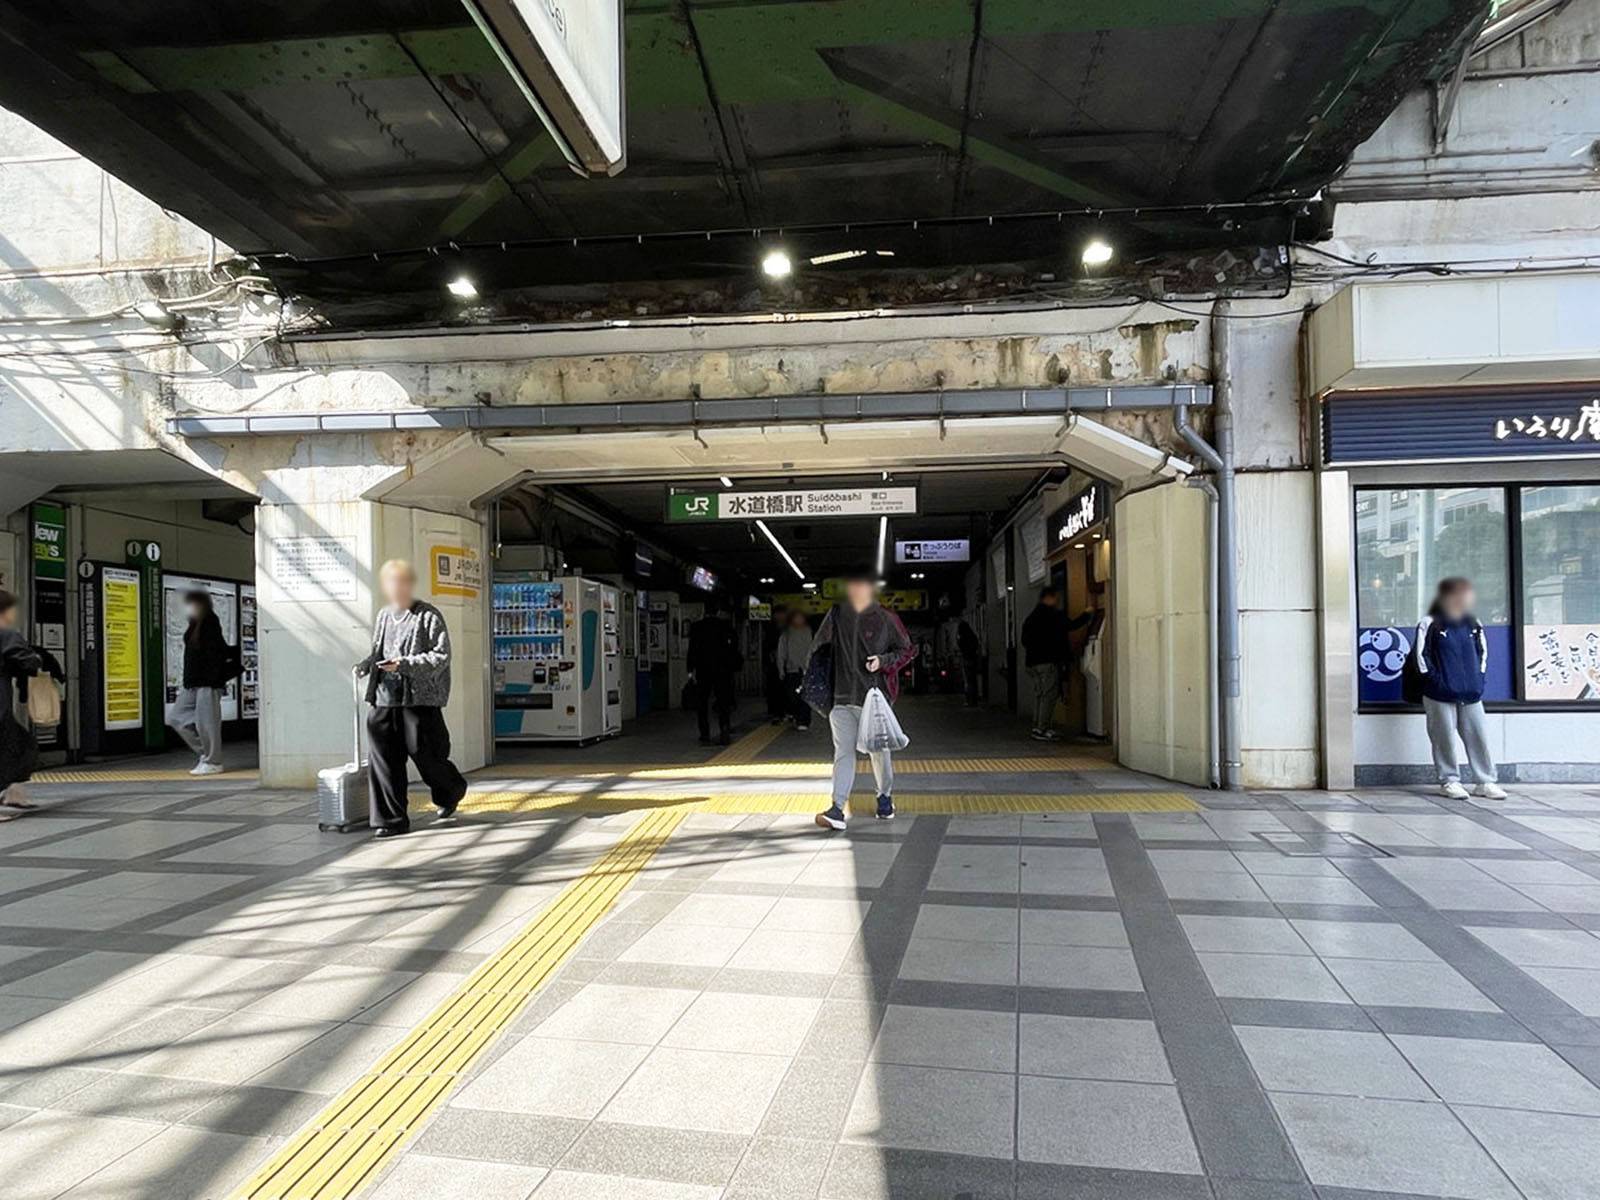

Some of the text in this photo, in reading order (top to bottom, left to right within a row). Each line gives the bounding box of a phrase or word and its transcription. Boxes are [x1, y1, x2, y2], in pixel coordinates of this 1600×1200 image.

[685, 497, 709, 511] JR
[728, 494, 803, 515] 水道橋駅
[807, 503, 842, 513] Station
